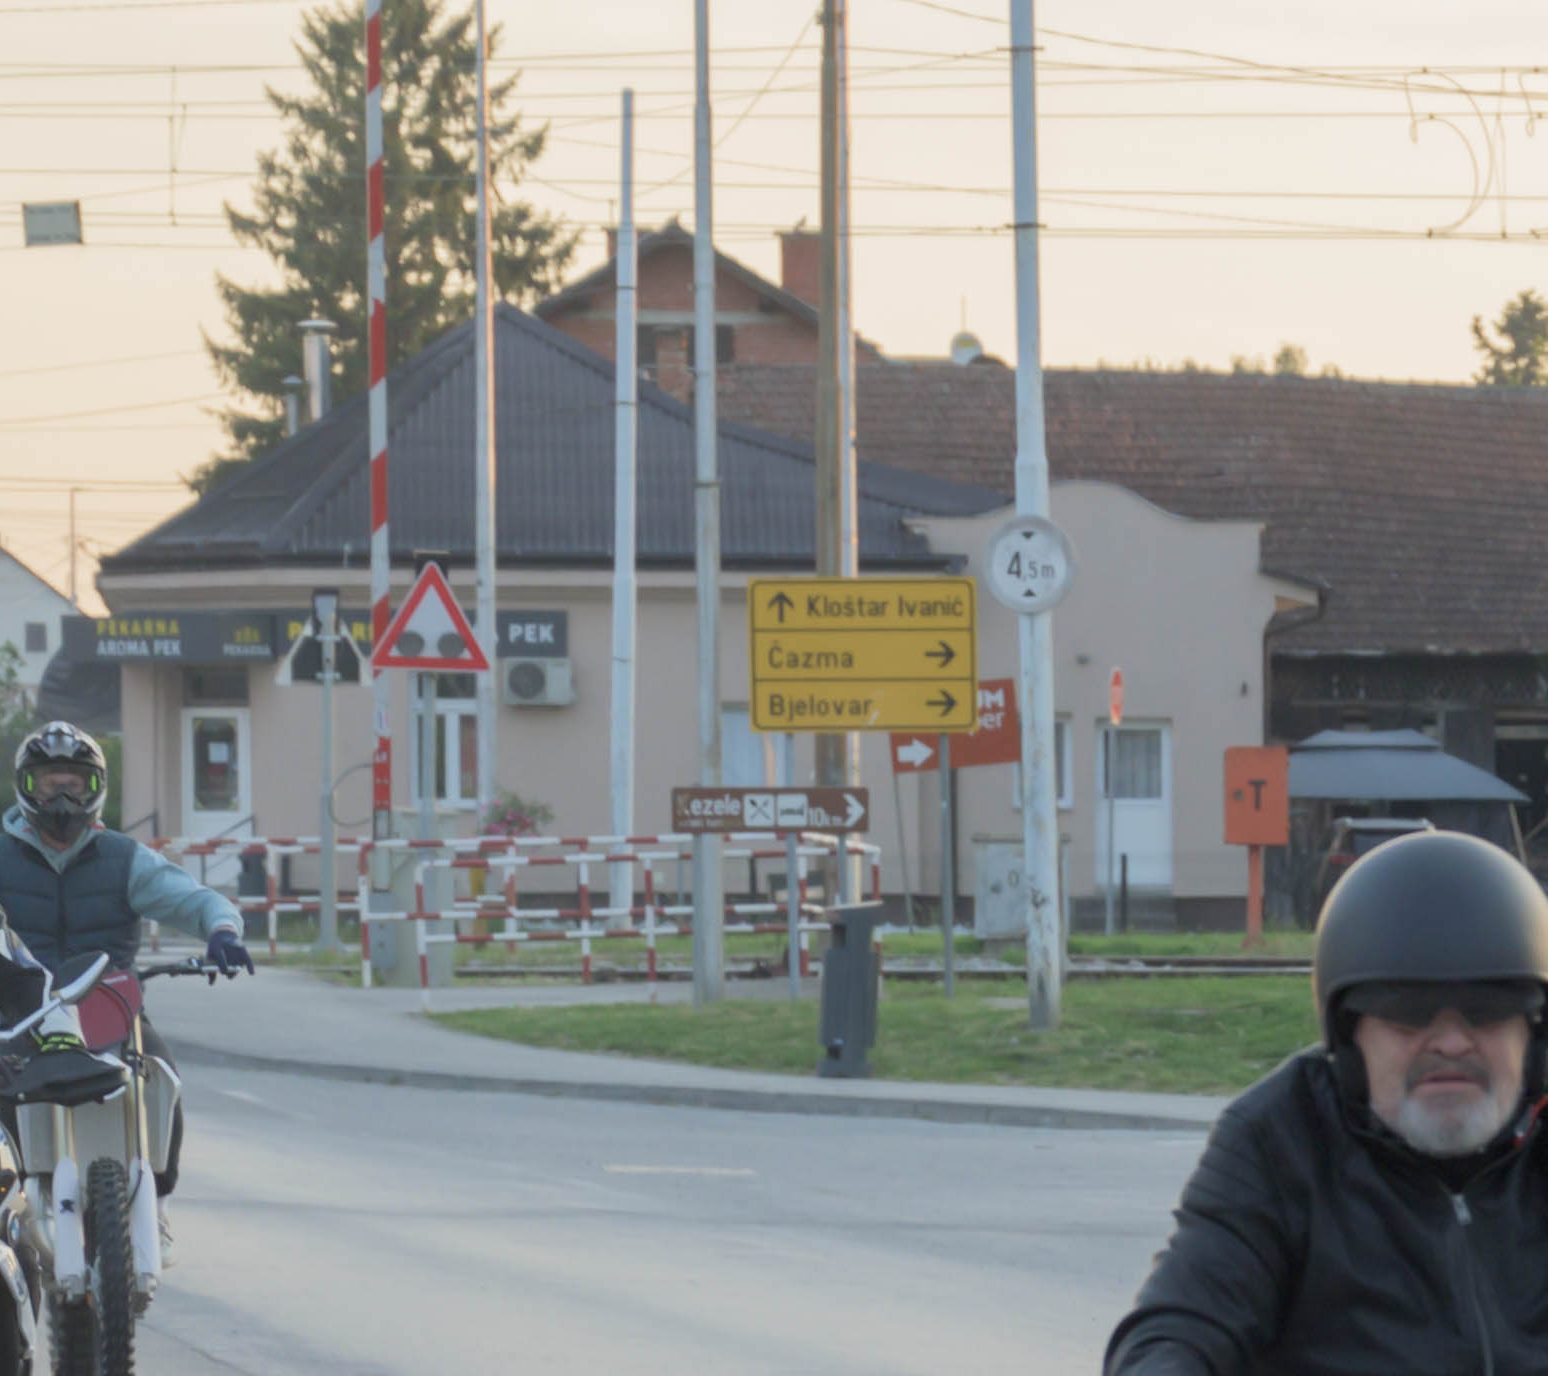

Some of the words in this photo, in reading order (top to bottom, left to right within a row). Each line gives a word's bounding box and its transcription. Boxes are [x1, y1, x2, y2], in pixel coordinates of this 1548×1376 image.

[806, 594, 888, 618] Kloštar
[898, 593, 965, 618] Ivanić
[508, 623, 555, 643] PEK
[96, 639, 150, 656] AROMA
[153, 639, 182, 656] PEK
[768, 640, 854, 669] Čazma
[769, 694, 873, 721] Bjelovar
[677, 793, 741, 816] Kezele
